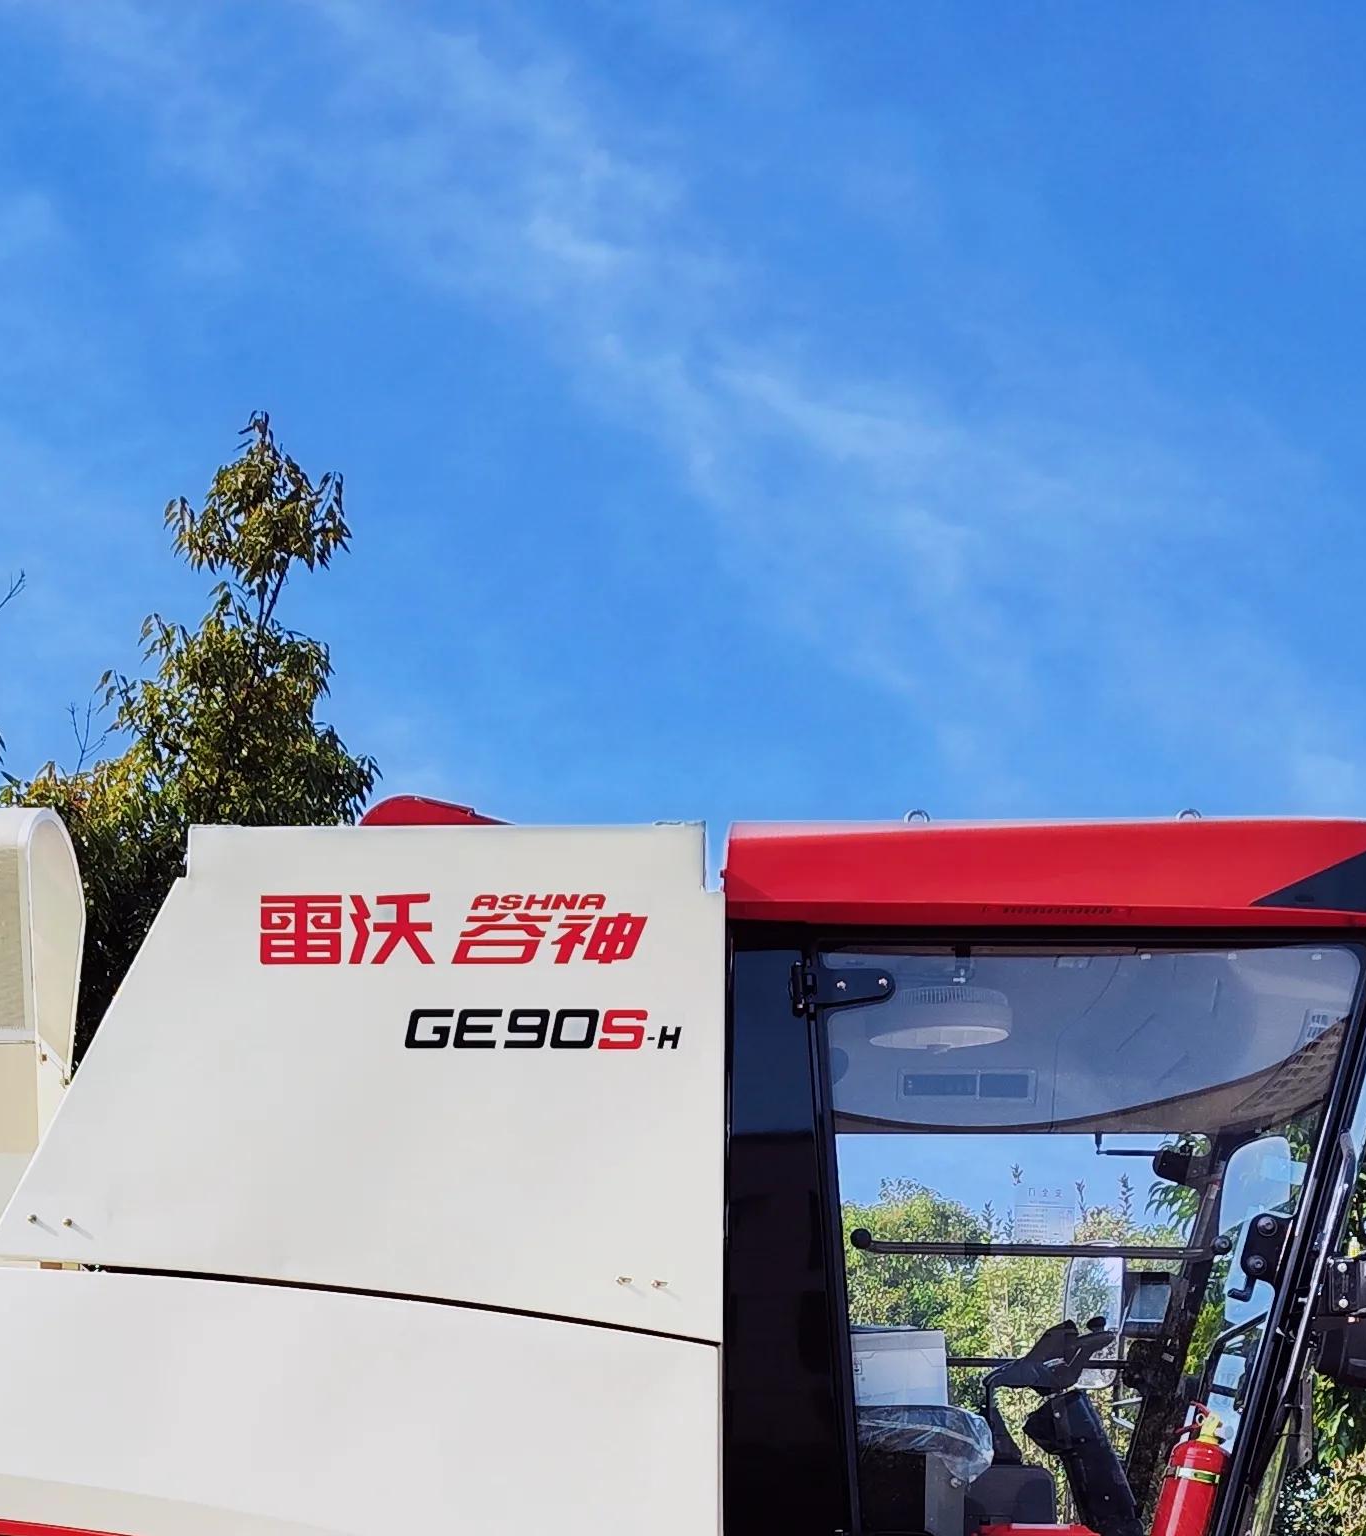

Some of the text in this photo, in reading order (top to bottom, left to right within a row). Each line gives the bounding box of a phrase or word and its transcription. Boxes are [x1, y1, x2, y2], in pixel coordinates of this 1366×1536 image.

[471, 894, 606, 910] ASHNA
[260, 893, 648, 964] 雷沃 谷神
[404, 1009, 682, 1049] GE90S-H
